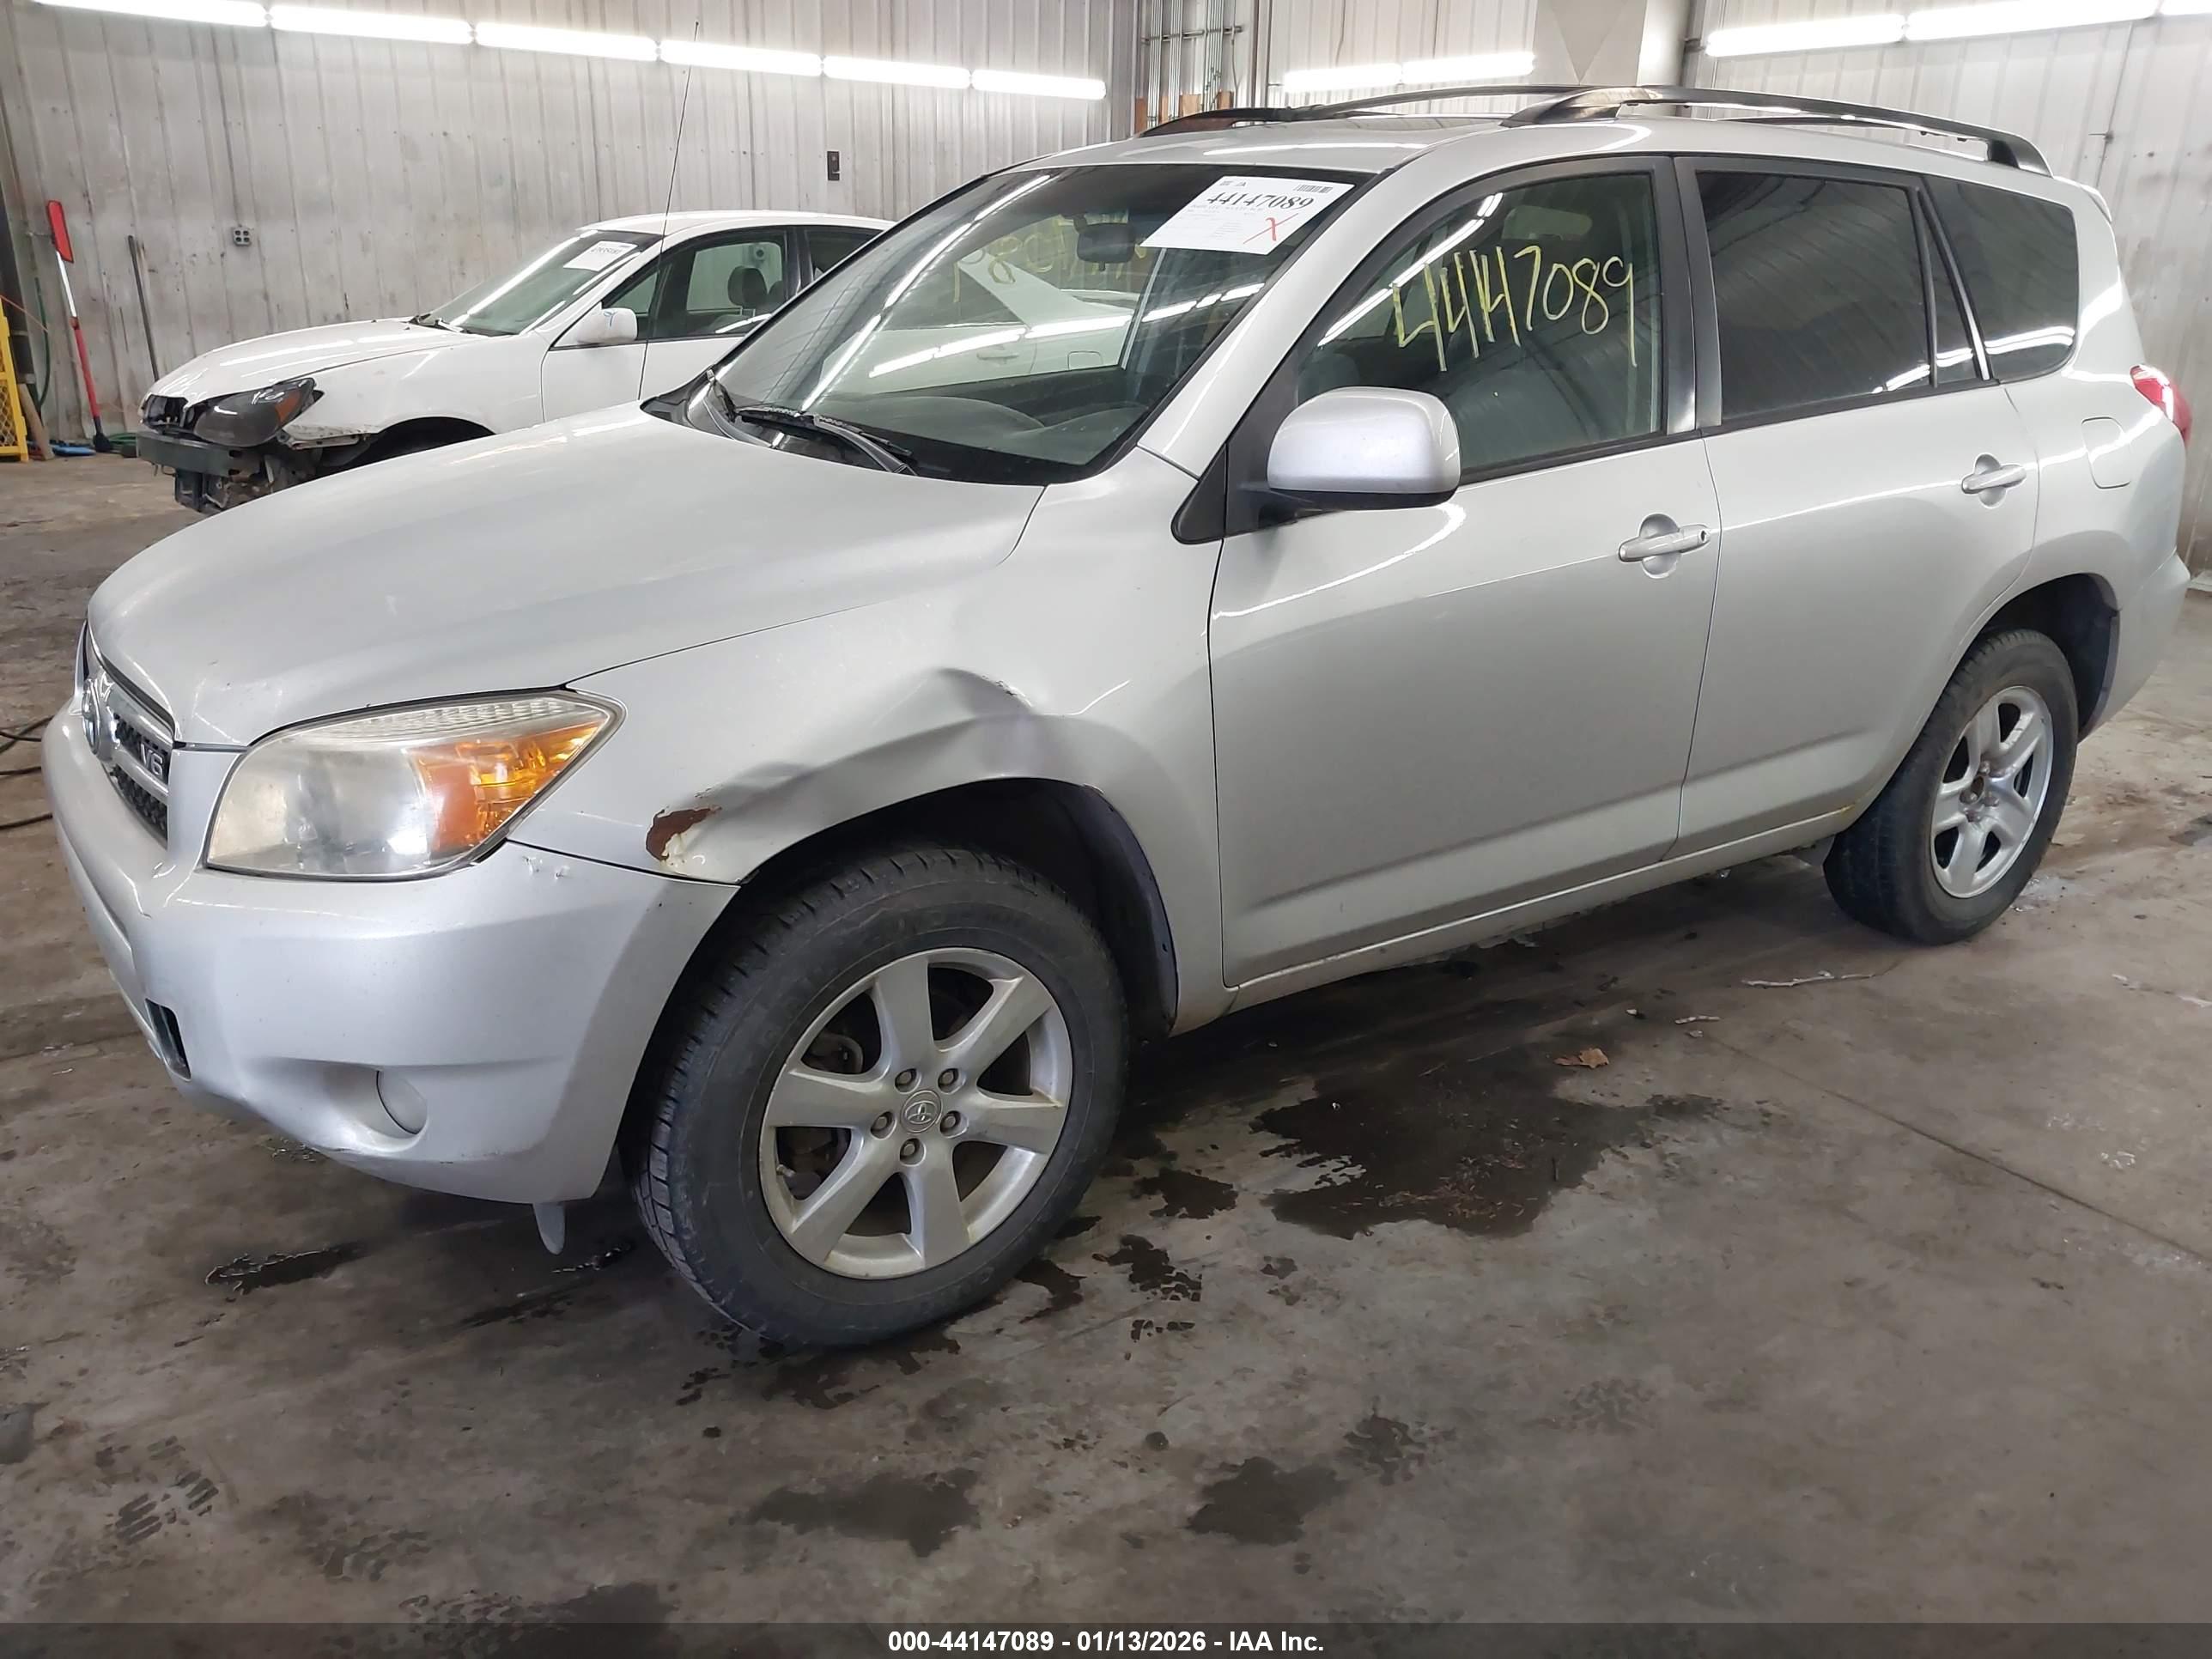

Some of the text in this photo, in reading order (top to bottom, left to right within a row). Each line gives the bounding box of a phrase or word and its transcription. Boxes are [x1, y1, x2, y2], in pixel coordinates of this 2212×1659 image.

[1206, 191, 1315, 210] 44147089
[1391, 244, 1638, 373] 44147089
[140, 743, 164, 777] V6
